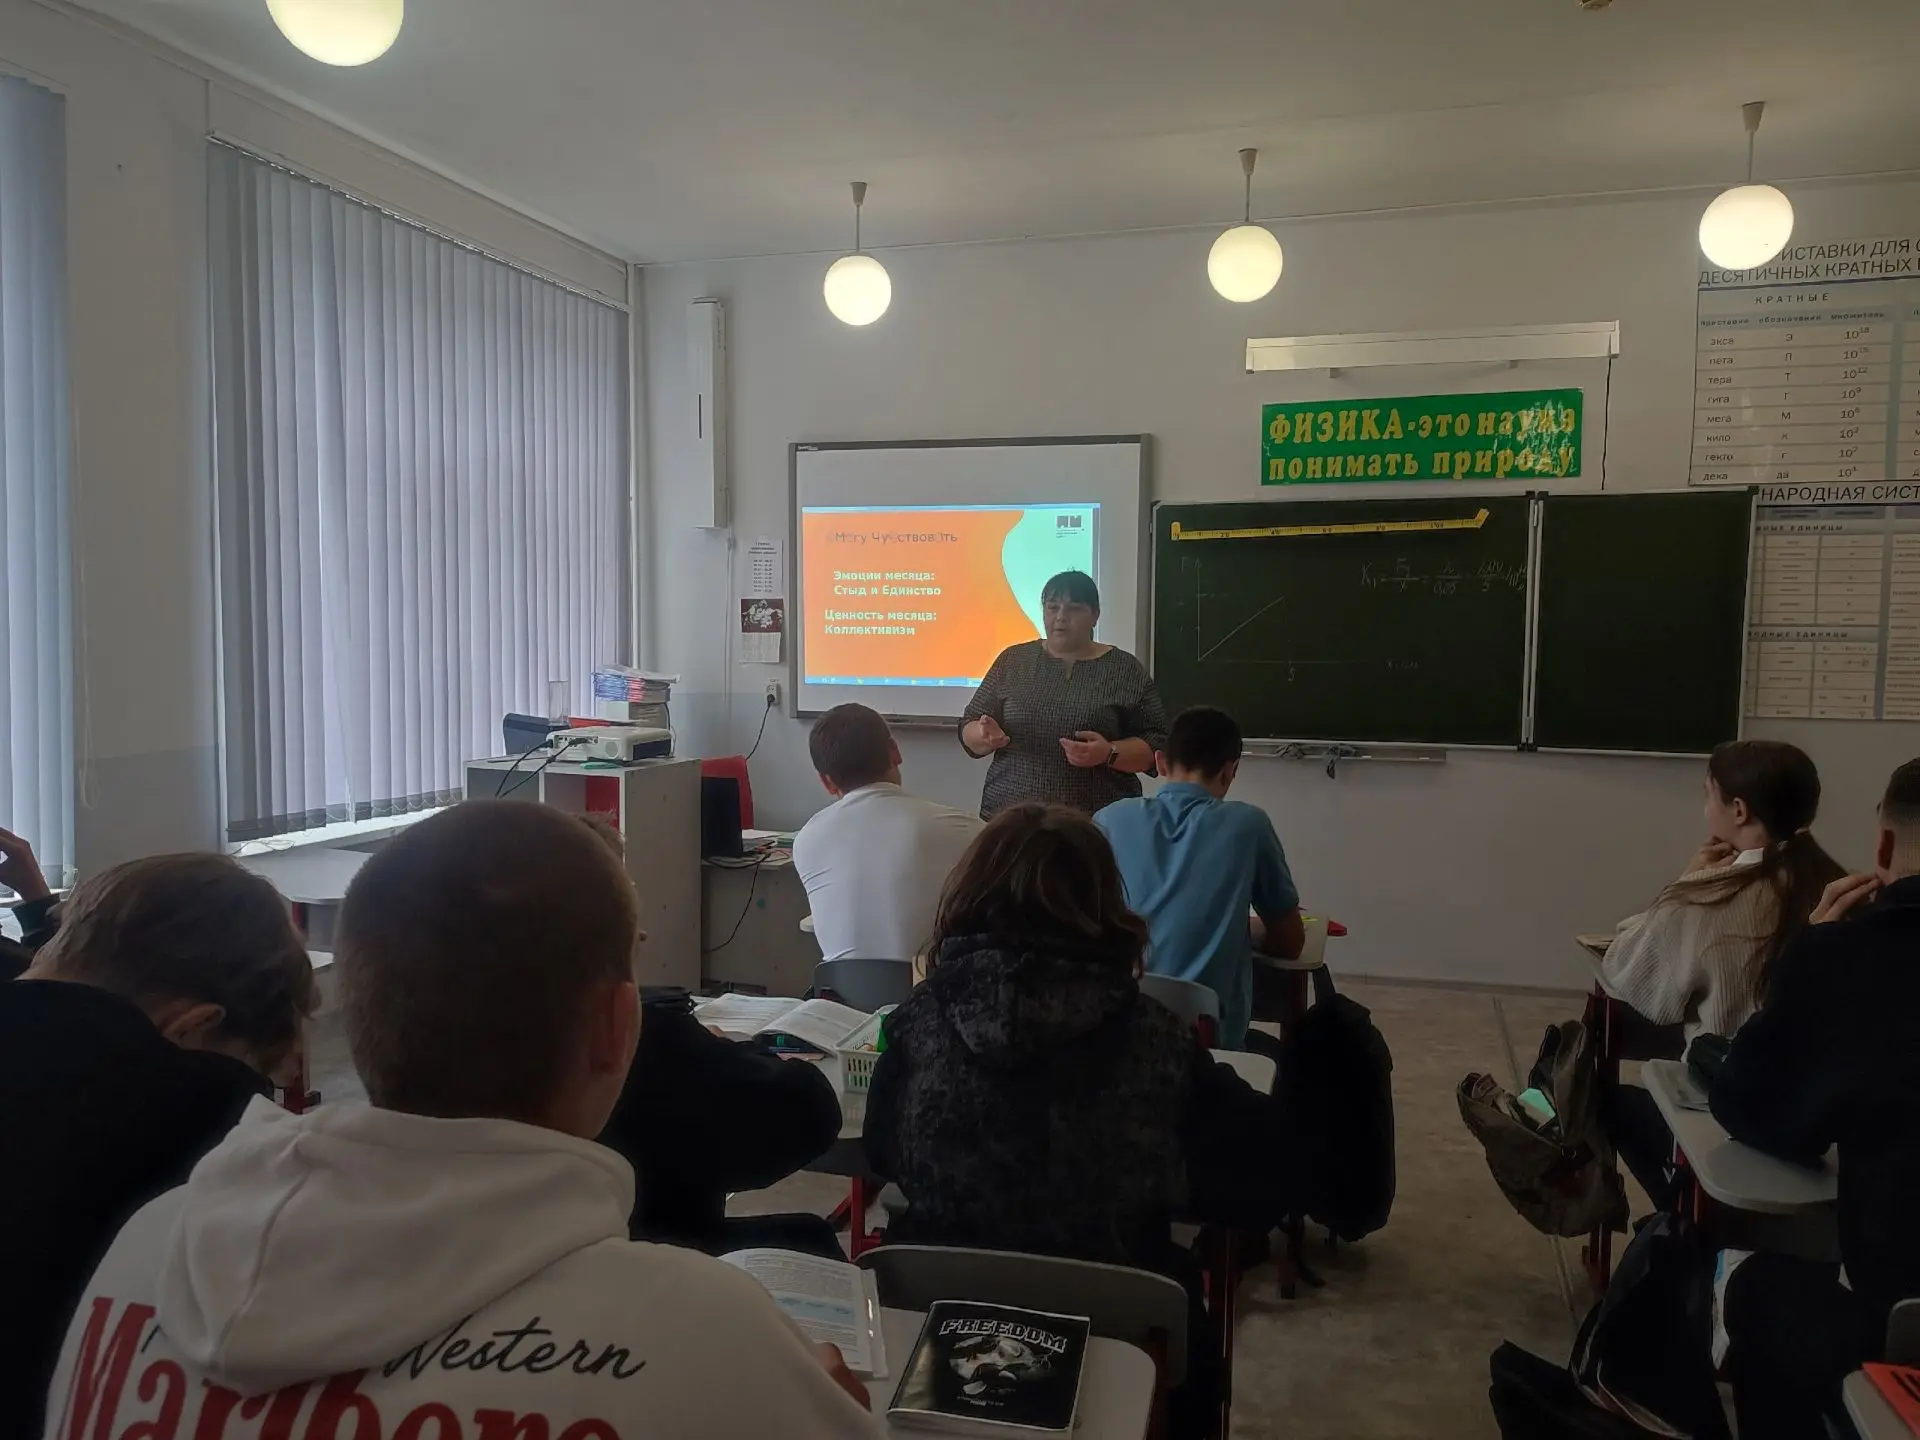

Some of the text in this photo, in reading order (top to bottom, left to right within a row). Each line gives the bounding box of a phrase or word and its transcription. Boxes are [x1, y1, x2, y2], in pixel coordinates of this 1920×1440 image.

[1780, 243, 1866, 262] ИСТАВКИ
[1869, 238, 1910, 258] ДЛЯ
[1826, 258, 1911, 278] КРАТНЫХ
[1755, 292, 1830, 305] КРАТНЫЕ
[1268, 452, 1420, 481] понимать
[1761, 486, 1866, 503] НАРОДНАЯ
[871, 530, 958, 545] Чуствовть
[833, 570, 936, 582] Эмоции месяца:
[834, 585, 942, 596] Стыд и Единство
[825, 610, 937, 622] Ценность месяца:
[825, 625, 916, 636] Коллективизм
[938, 1317, 1068, 1354] FREEDOM
[383, 1314, 647, 1380] Western
[56, 1296, 623, 1440] Marlb
